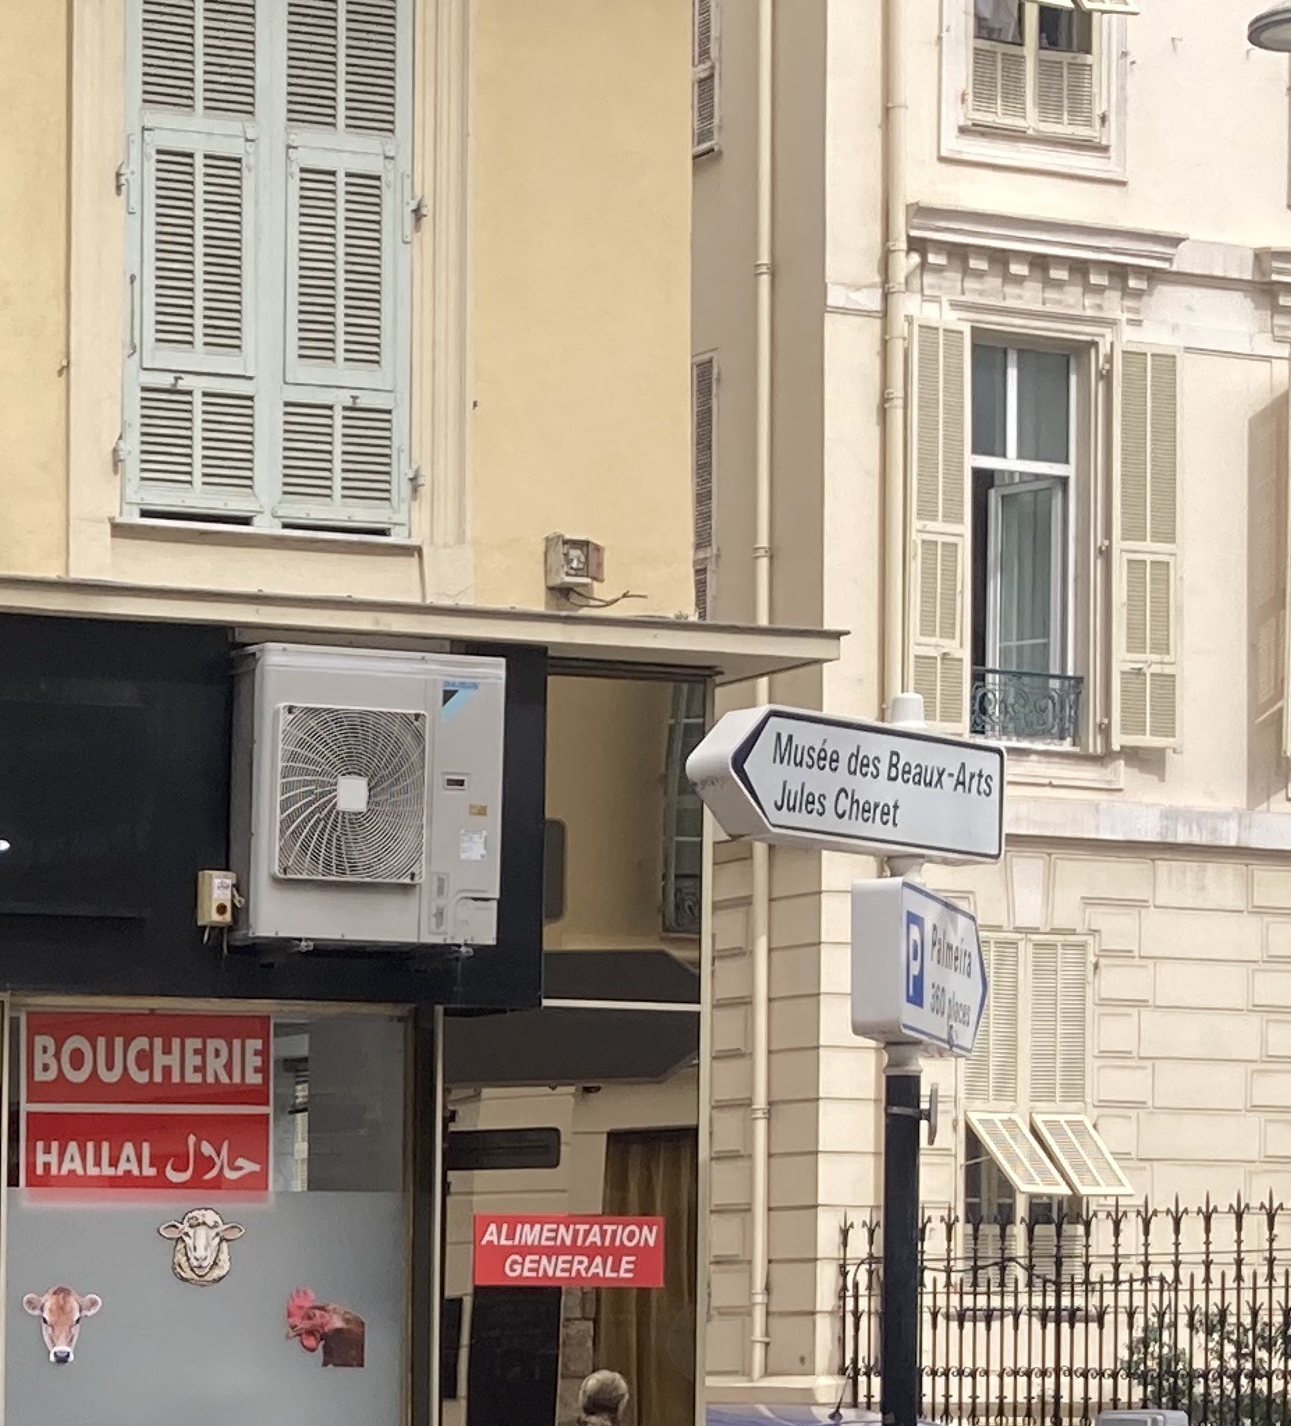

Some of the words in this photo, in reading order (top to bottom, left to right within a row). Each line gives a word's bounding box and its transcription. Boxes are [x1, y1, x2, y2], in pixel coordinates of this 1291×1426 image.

[772, 731, 840, 773] Musée
[847, 745, 881, 780] des
[886, 750, 994, 798] Beaux-Arts
[774, 780, 826, 817] Jules
[834, 787, 900, 828] Cheret
[909, 924, 921, 996] P
[930, 923, 973, 979] Palmeira
[947, 991, 972, 1027] places
[33, 1034, 264, 1085] BOUCHERIE
[35, 1140, 157, 1177] HALLAL
[165, 1133, 262, 1183] حلال
[481, 1222, 658, 1247] ALIMENTATION
[504, 1254, 637, 1279] GENERALE
